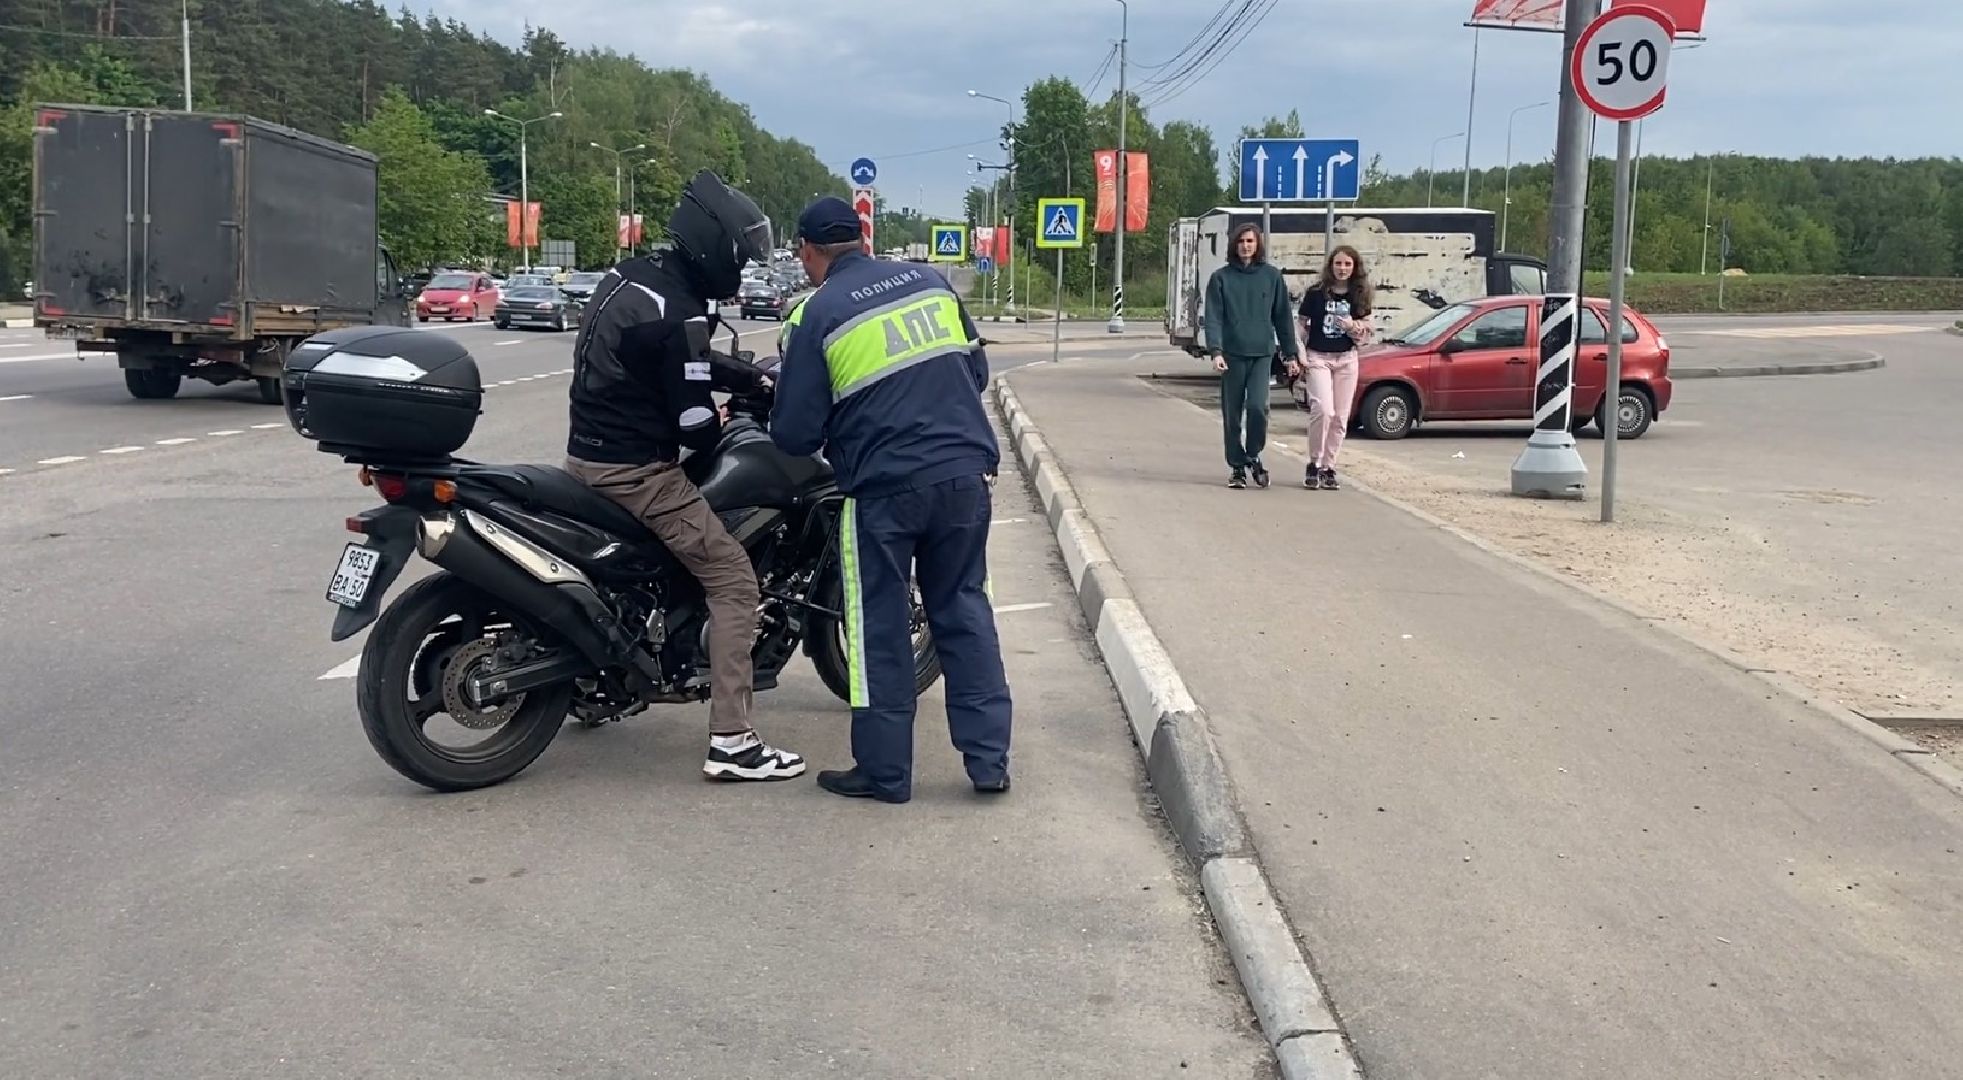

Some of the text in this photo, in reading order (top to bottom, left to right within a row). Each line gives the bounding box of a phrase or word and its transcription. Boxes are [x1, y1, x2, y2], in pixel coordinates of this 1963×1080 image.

[1597, 39, 1657, 85] 50
[851, 269, 922, 301] ПОЛИЦИЯ
[882, 302, 951, 358] ДПС
[347, 550, 374, 571] 9853
[349, 579, 364, 598] 50
